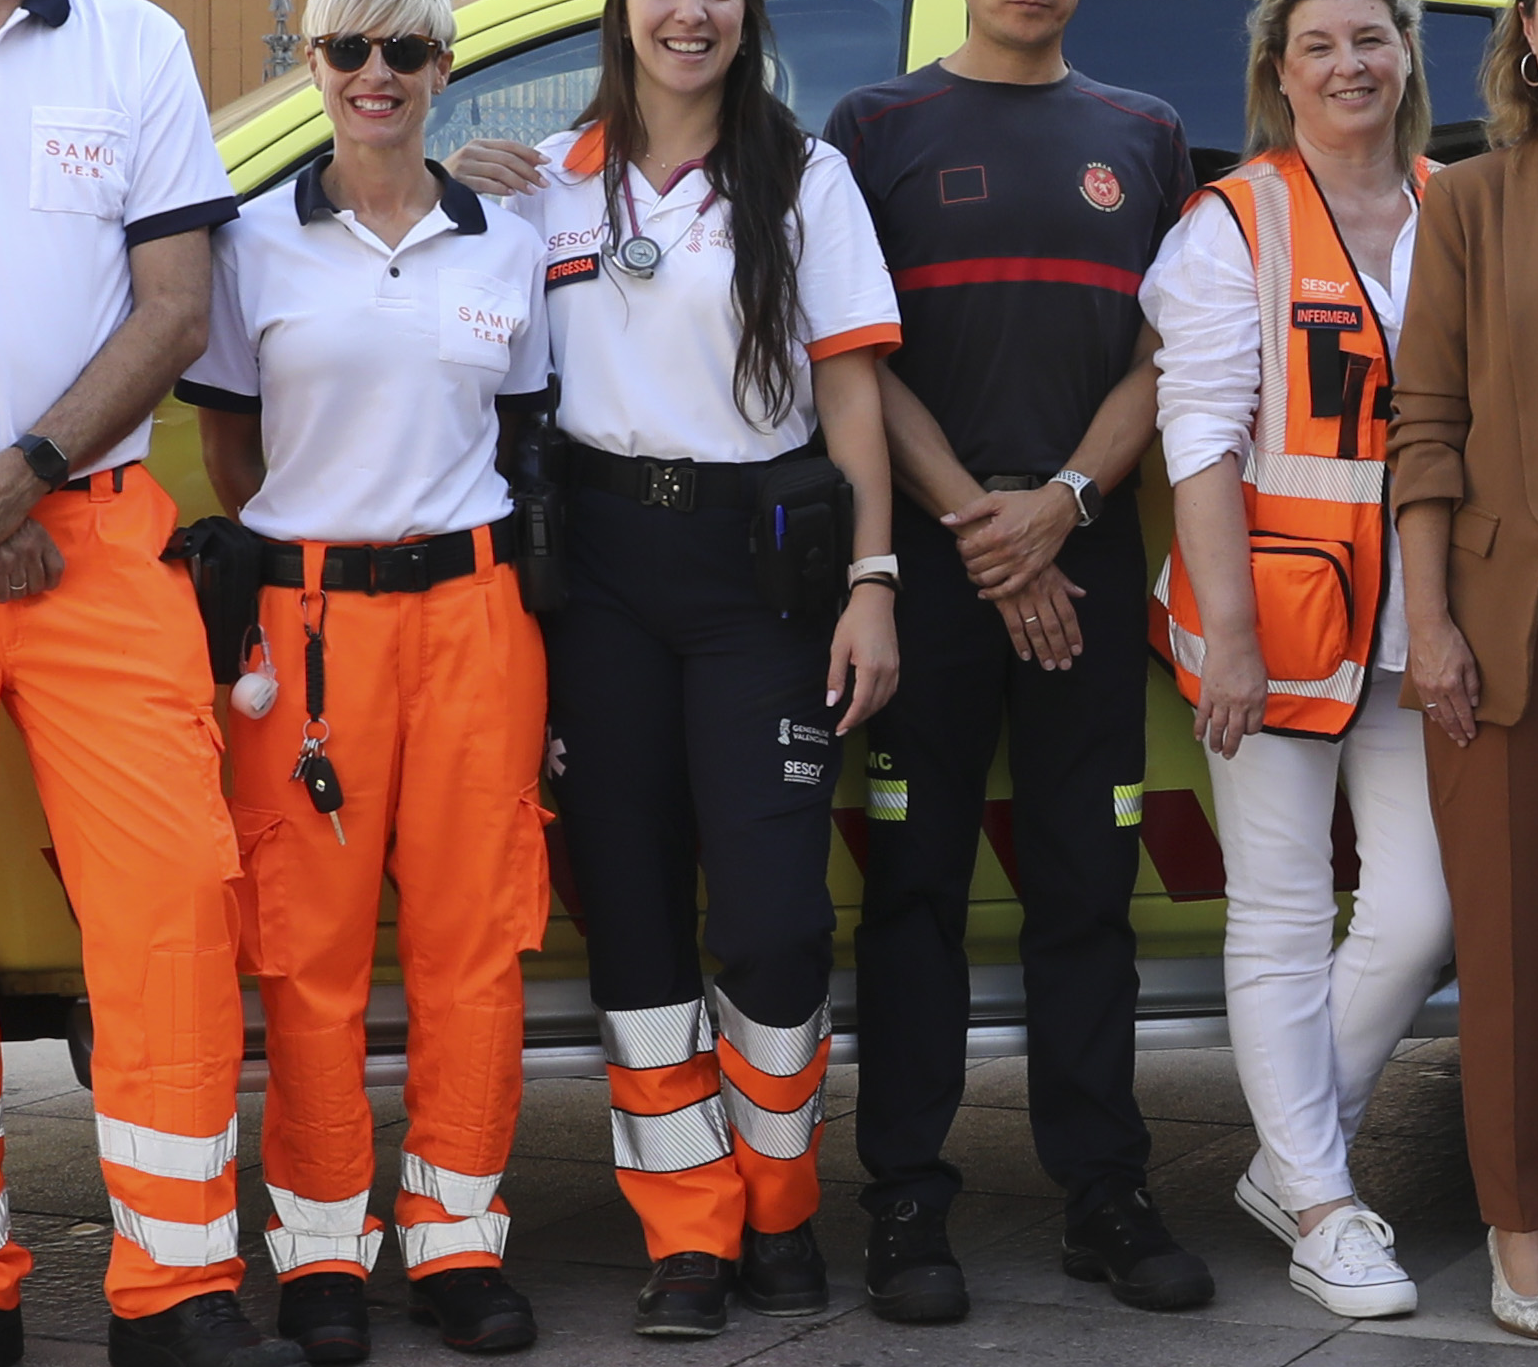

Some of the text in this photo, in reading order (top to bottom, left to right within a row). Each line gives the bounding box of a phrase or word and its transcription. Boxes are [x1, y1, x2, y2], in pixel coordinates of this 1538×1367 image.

[46, 139, 114, 166] SAMU
[61, 163, 104, 179] T.E.S.
[548, 225, 603, 251] SESCV
[1301, 277, 1347, 293] SESCV
[457, 306, 518, 332] SAMU
[1297, 309, 1358, 325] INFERMERA
[784, 760, 823, 777] SESCV
